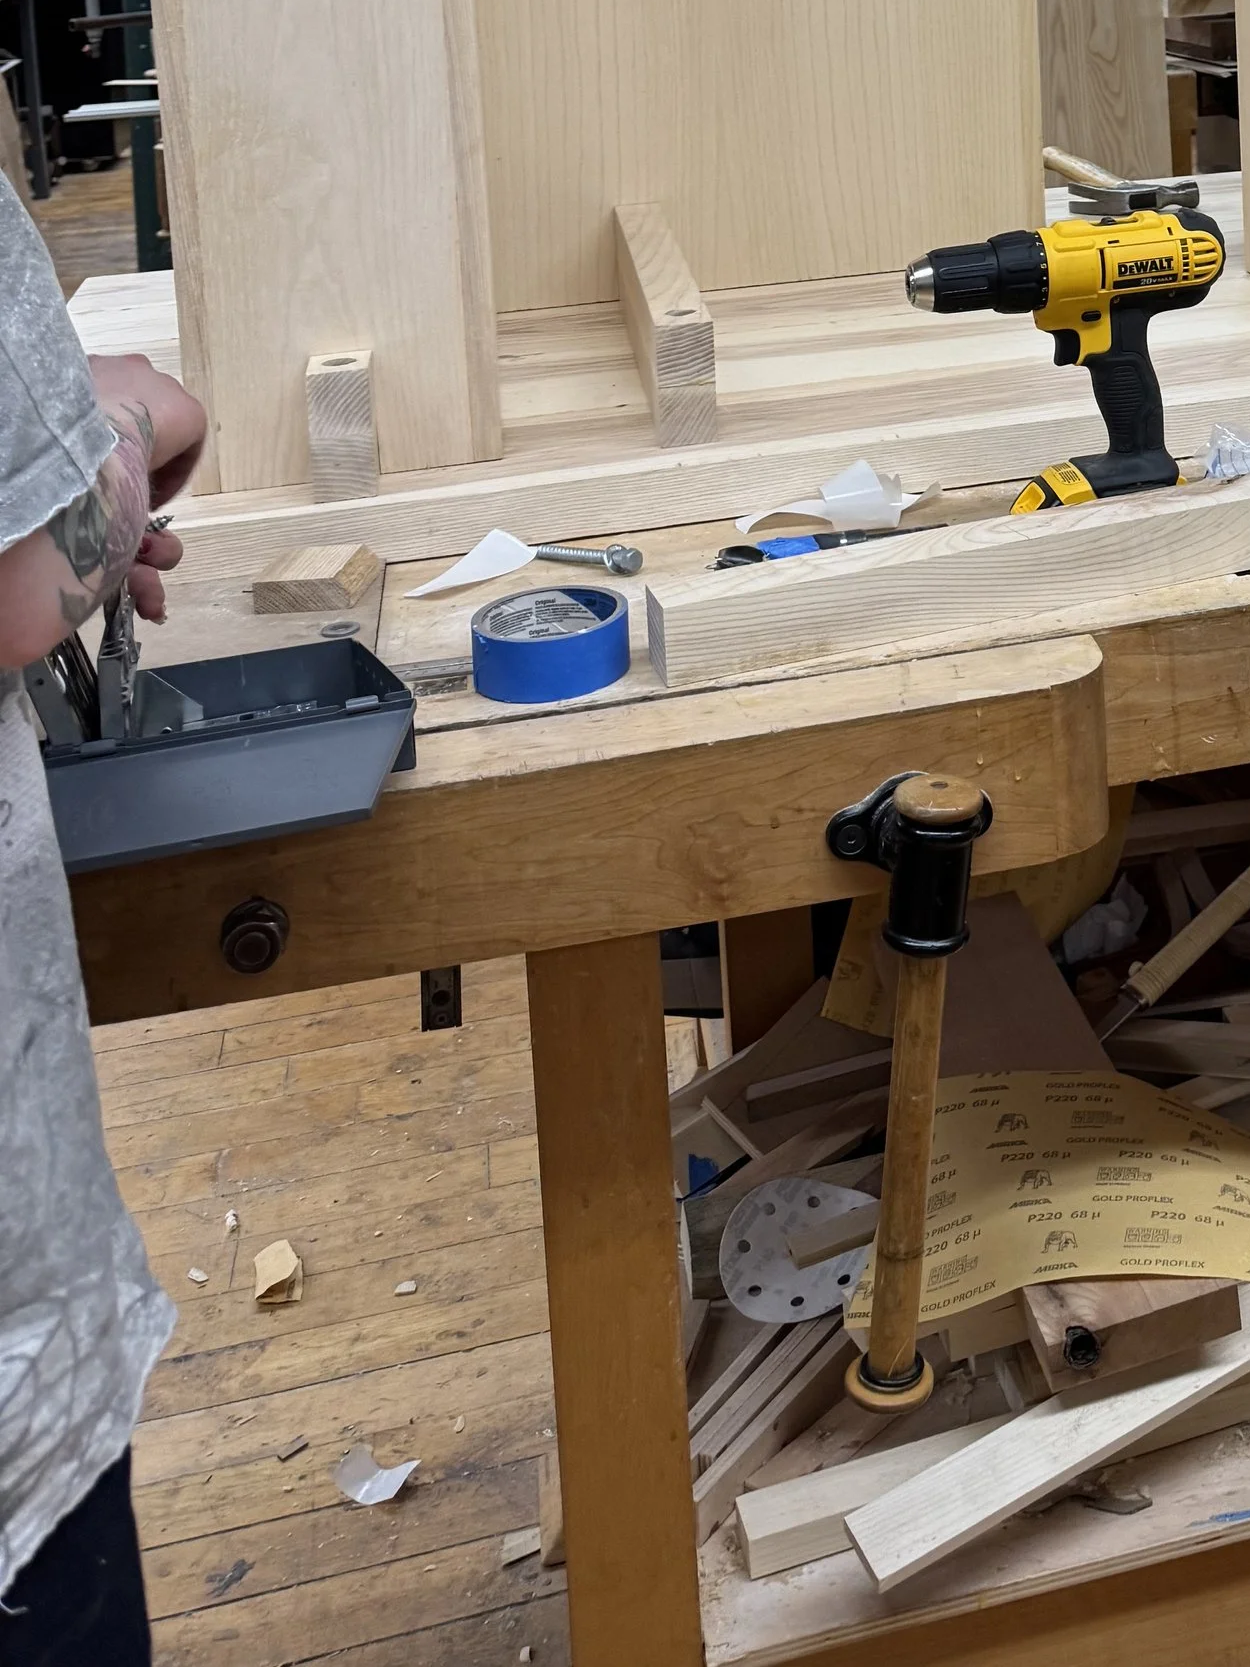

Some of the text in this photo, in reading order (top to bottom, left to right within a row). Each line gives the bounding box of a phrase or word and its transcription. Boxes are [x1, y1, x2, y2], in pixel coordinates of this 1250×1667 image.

[1045, 1094, 1078, 1104] P220
[1001, 1151, 1034, 1163] P220
[1042, 1151, 1060, 1159] 68
[1118, 1150, 1153, 1159] P220
[1160, 1154, 1177, 1164] 68
[931, 1172, 946, 1185] 68
[1092, 1195, 1174, 1205] GOLD PROFLEX
[1027, 1211, 1063, 1223] P220
[1070, 1210, 1089, 1220] 68
[1150, 1210, 1187, 1221] P220
[1194, 1214, 1212, 1225] 68
[931, 1213, 974, 1238] PROFLEX
[954, 1232, 970, 1245] 68
[1032, 1261, 1079, 1275] MIRKA
[1120, 1258, 1206, 1269] GOLD PROFLEX
[920, 1279, 997, 1314] GOLD PROFLEX
